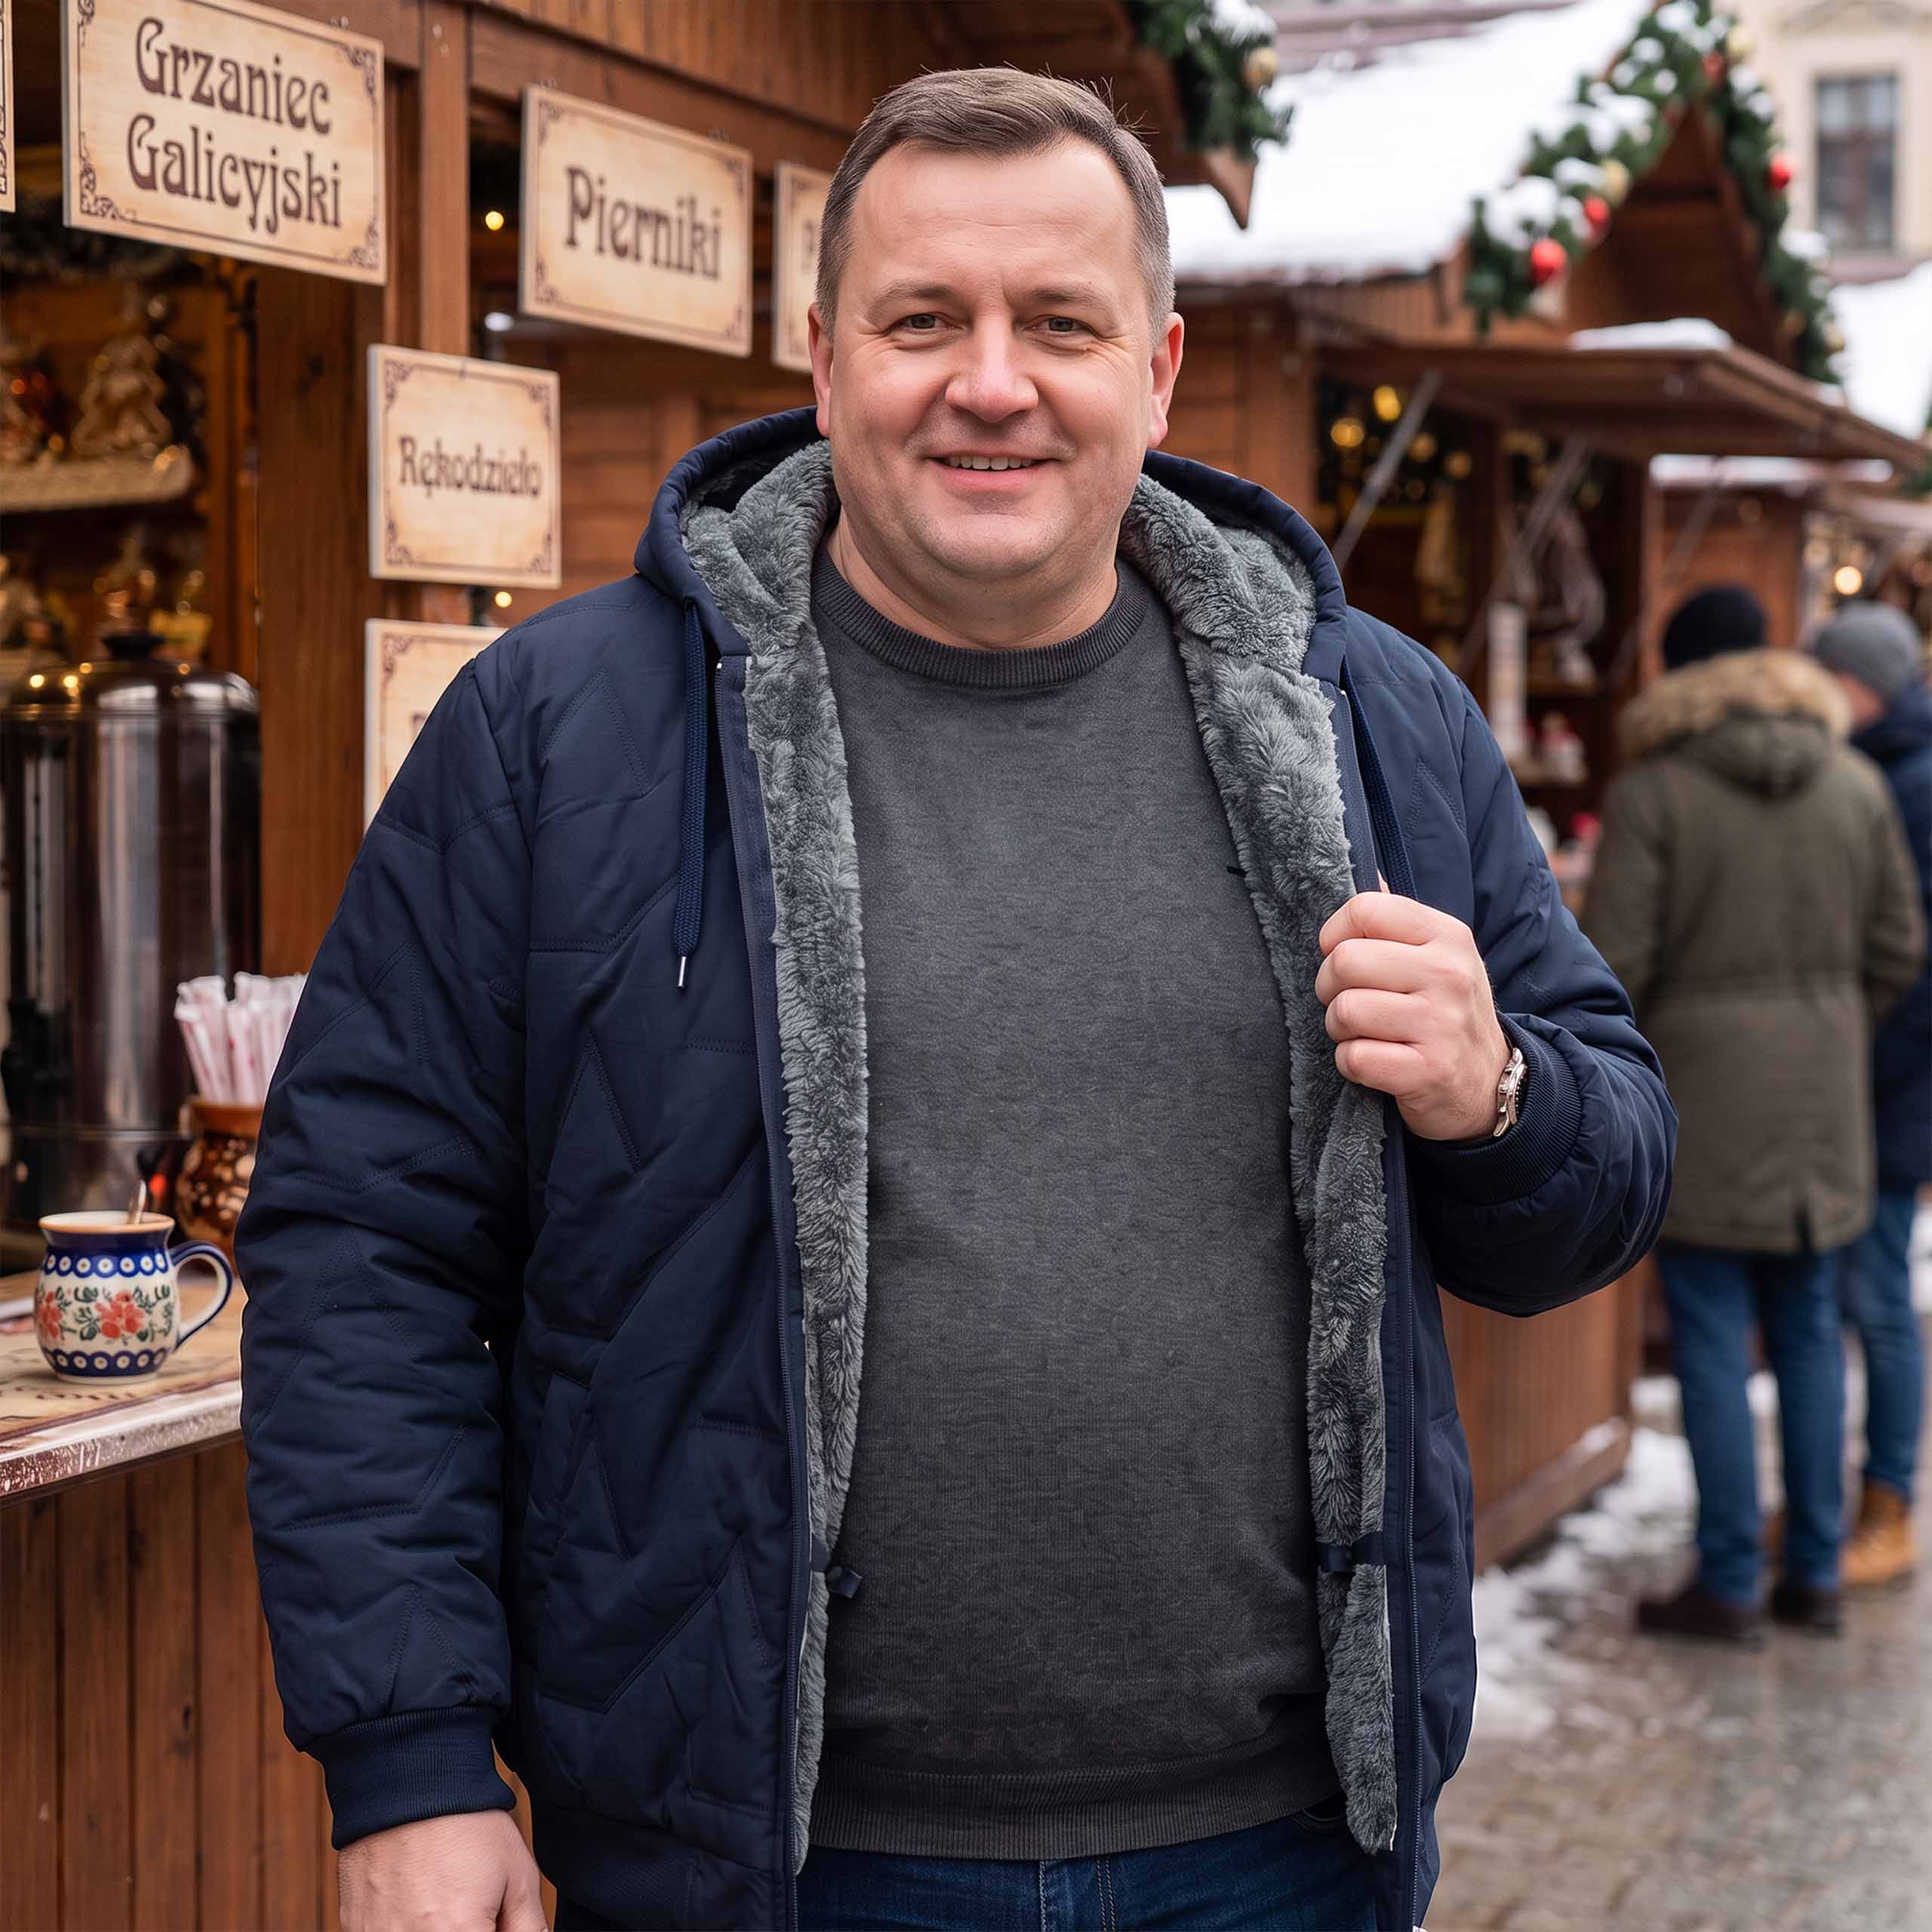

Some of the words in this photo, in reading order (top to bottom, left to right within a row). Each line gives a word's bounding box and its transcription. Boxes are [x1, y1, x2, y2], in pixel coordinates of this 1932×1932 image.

[135, 17, 331, 134] Grzaniec
[128, 113, 342, 234] Galicyjski
[565, 165, 721, 280] Pierniki
